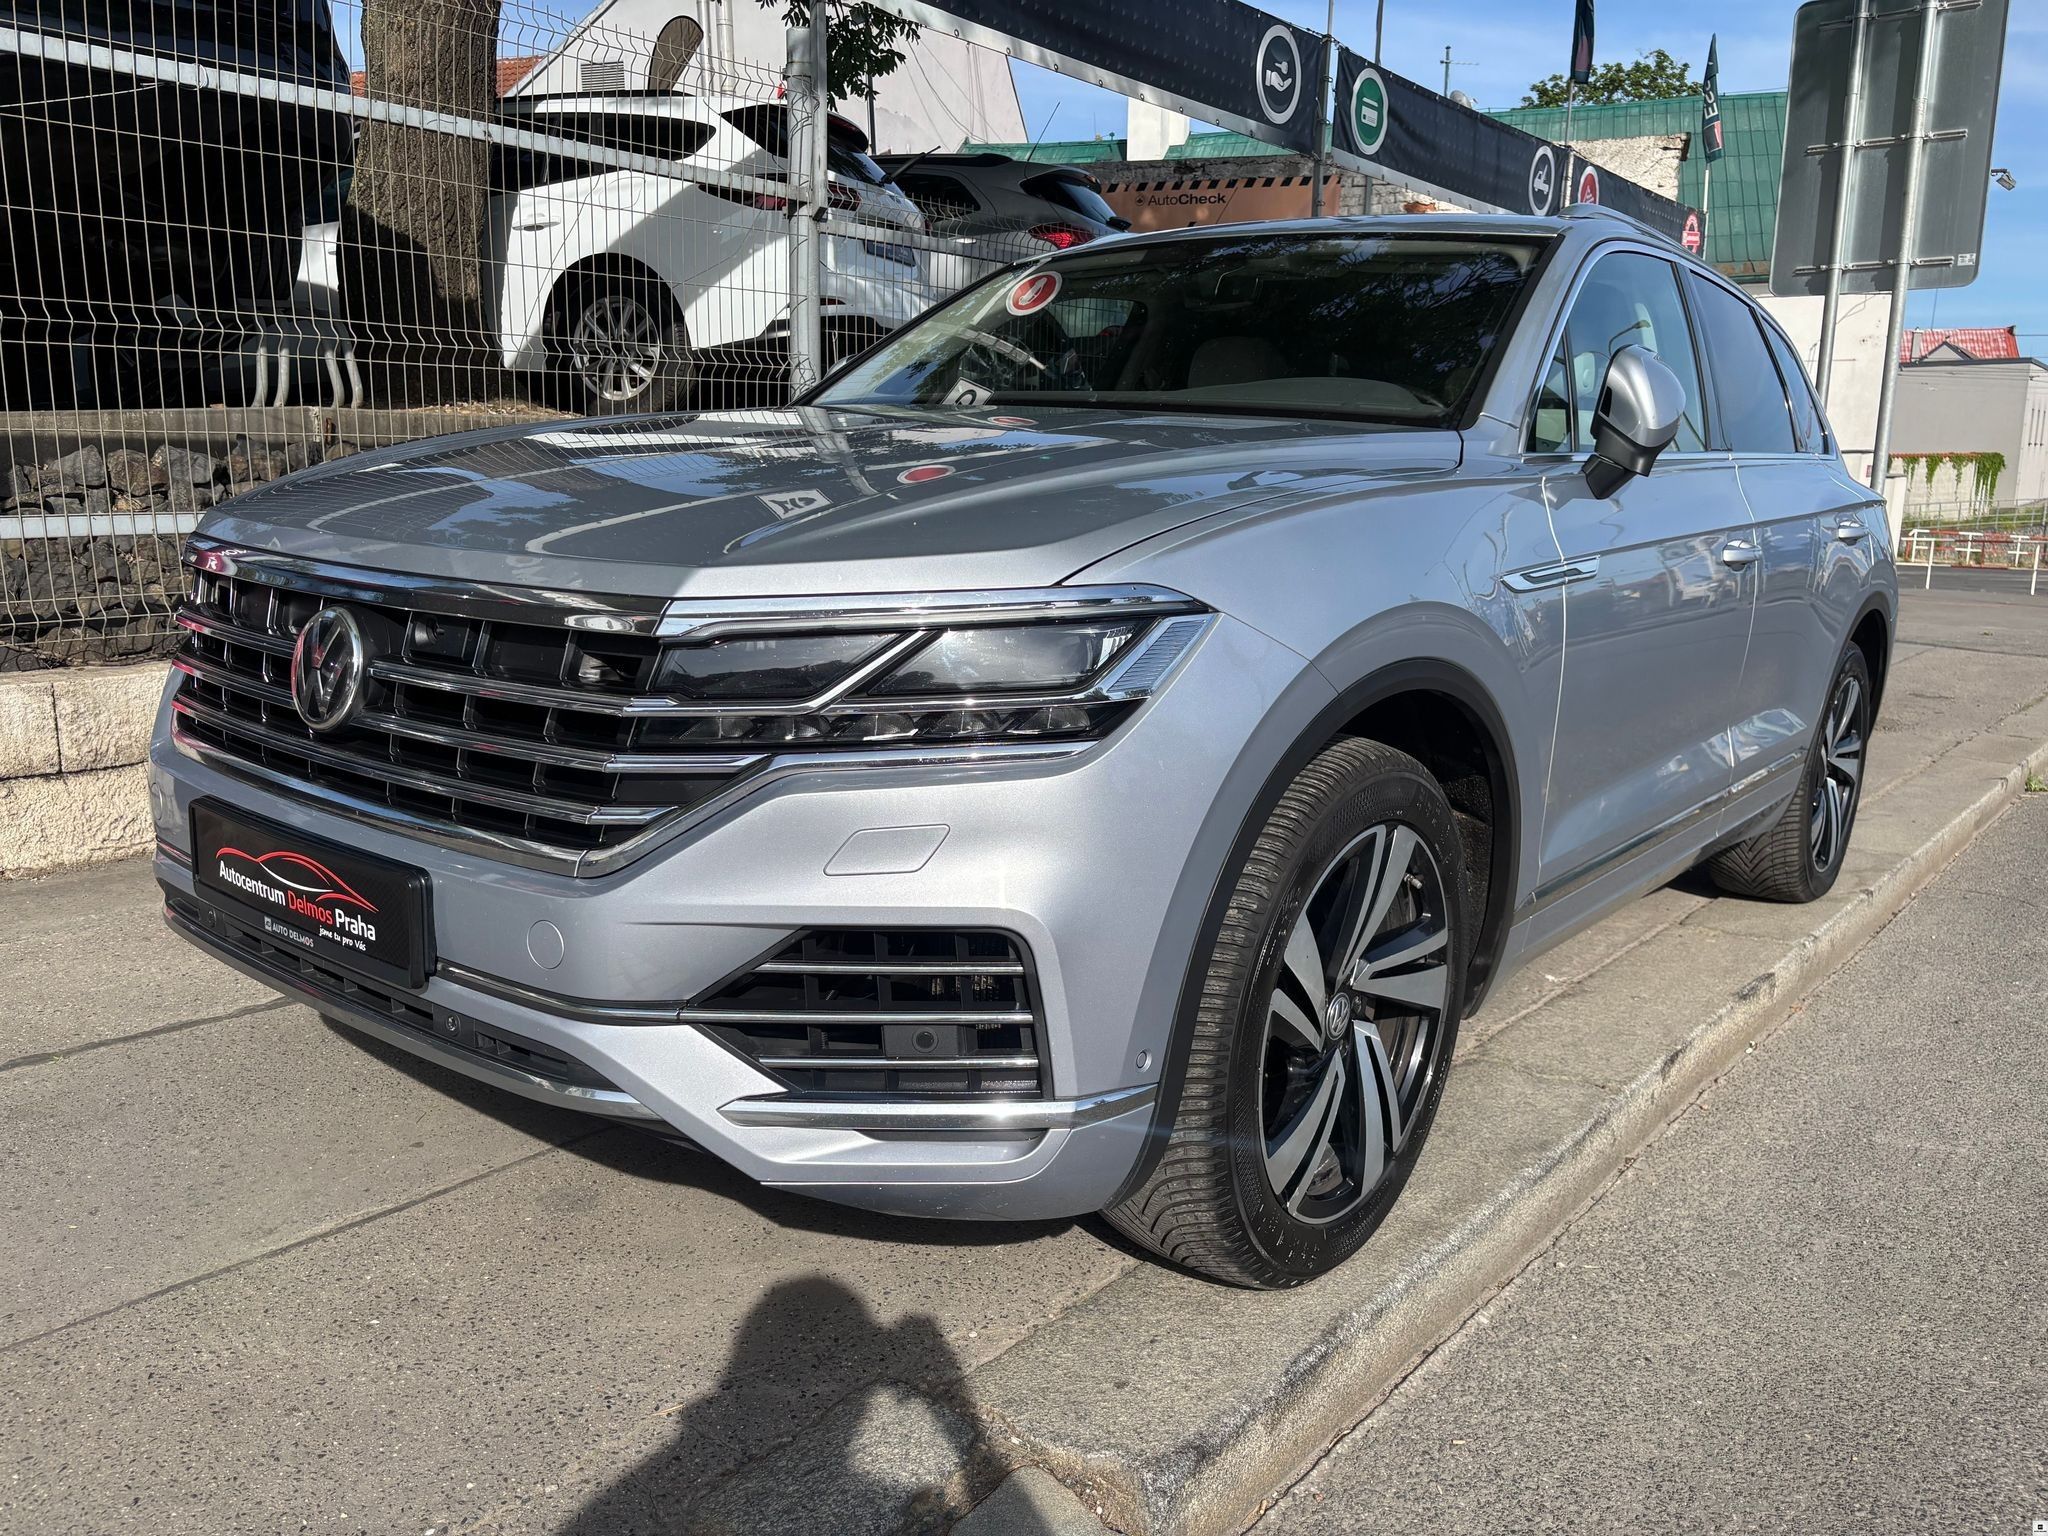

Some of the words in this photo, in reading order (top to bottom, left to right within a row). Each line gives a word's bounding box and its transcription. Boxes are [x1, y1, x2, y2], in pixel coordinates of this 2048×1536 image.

[1147, 192, 1227, 206] AutoCheck
[219, 860, 286, 907] Autocentrum
[287, 890, 333, 925] Delmos
[335, 909, 376, 941] Praha
[272, 922, 289, 937] AUTO
[289, 929, 314, 948] DELMOS
[334, 932, 341, 941] tu
[342, 936, 353, 946] pro
